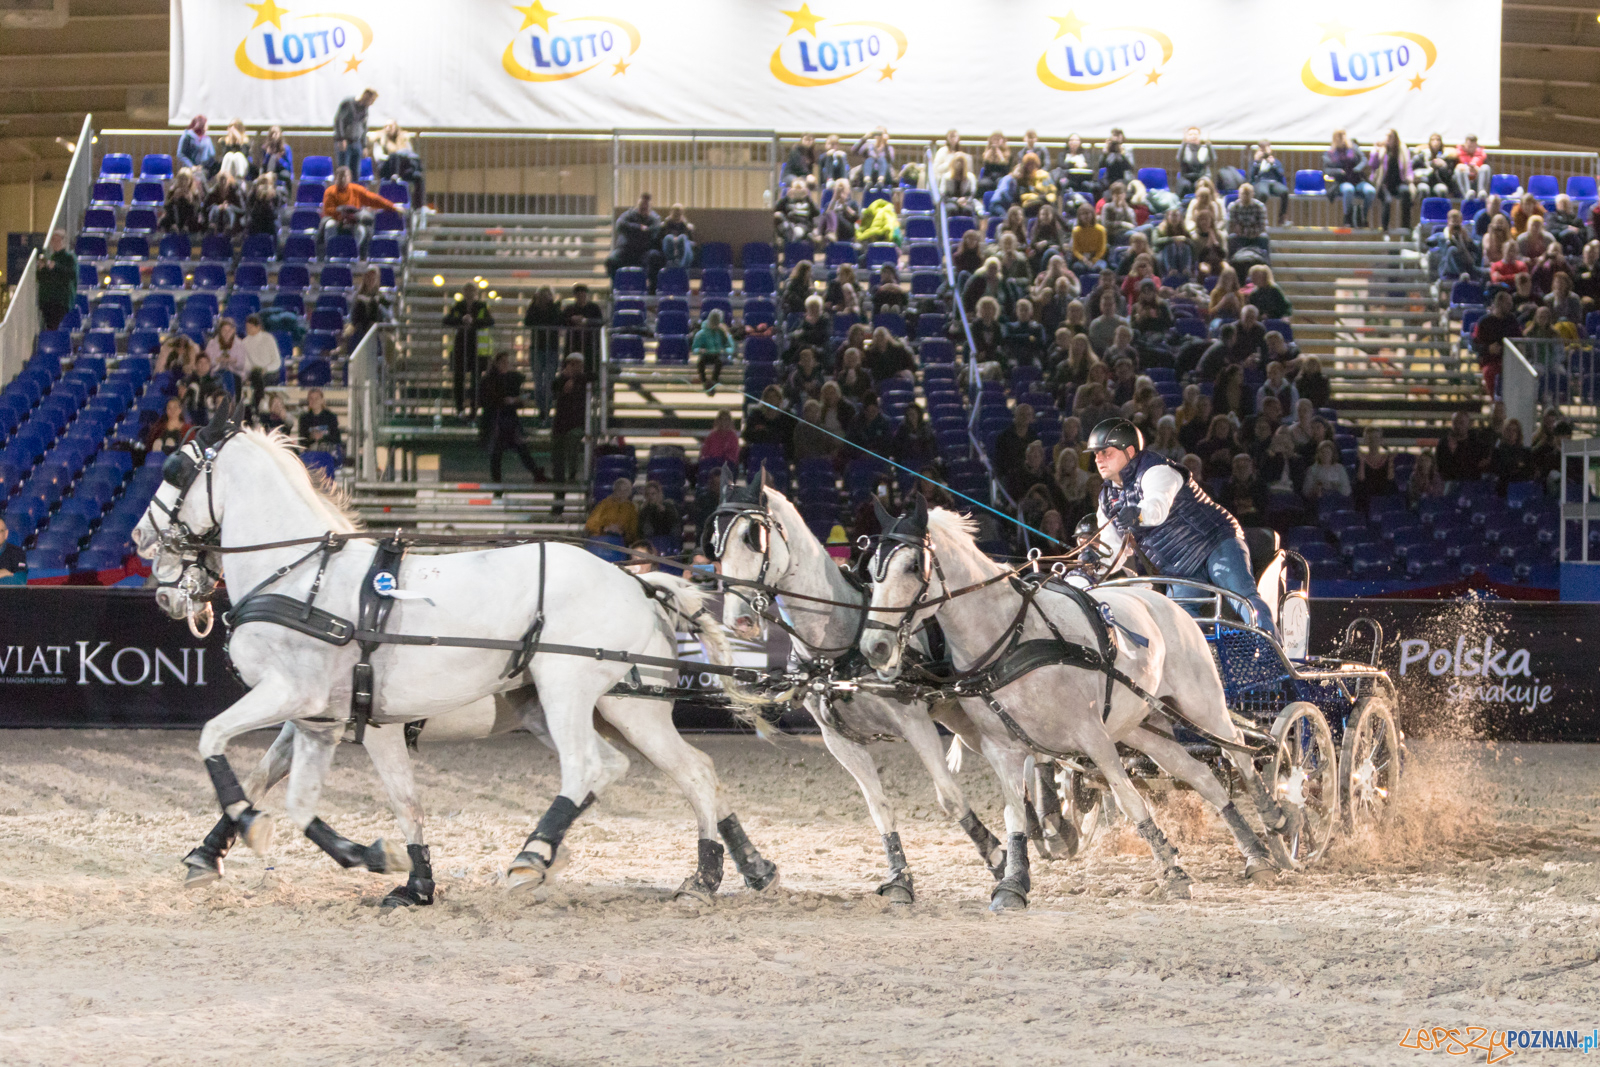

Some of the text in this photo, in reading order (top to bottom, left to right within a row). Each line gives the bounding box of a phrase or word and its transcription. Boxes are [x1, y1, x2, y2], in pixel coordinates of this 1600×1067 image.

[262, 26, 346, 66] LOTTO
[530, 30, 614, 68] LOTTO
[798, 34, 880, 73] LOTTO
[1065, 39, 1147, 78] LOTTO
[1329, 44, 1410, 83] LOTTO
[75, 640, 208, 686] KONI
[1399, 634, 1532, 677] Polska
[1446, 678, 1553, 713] smakuje
